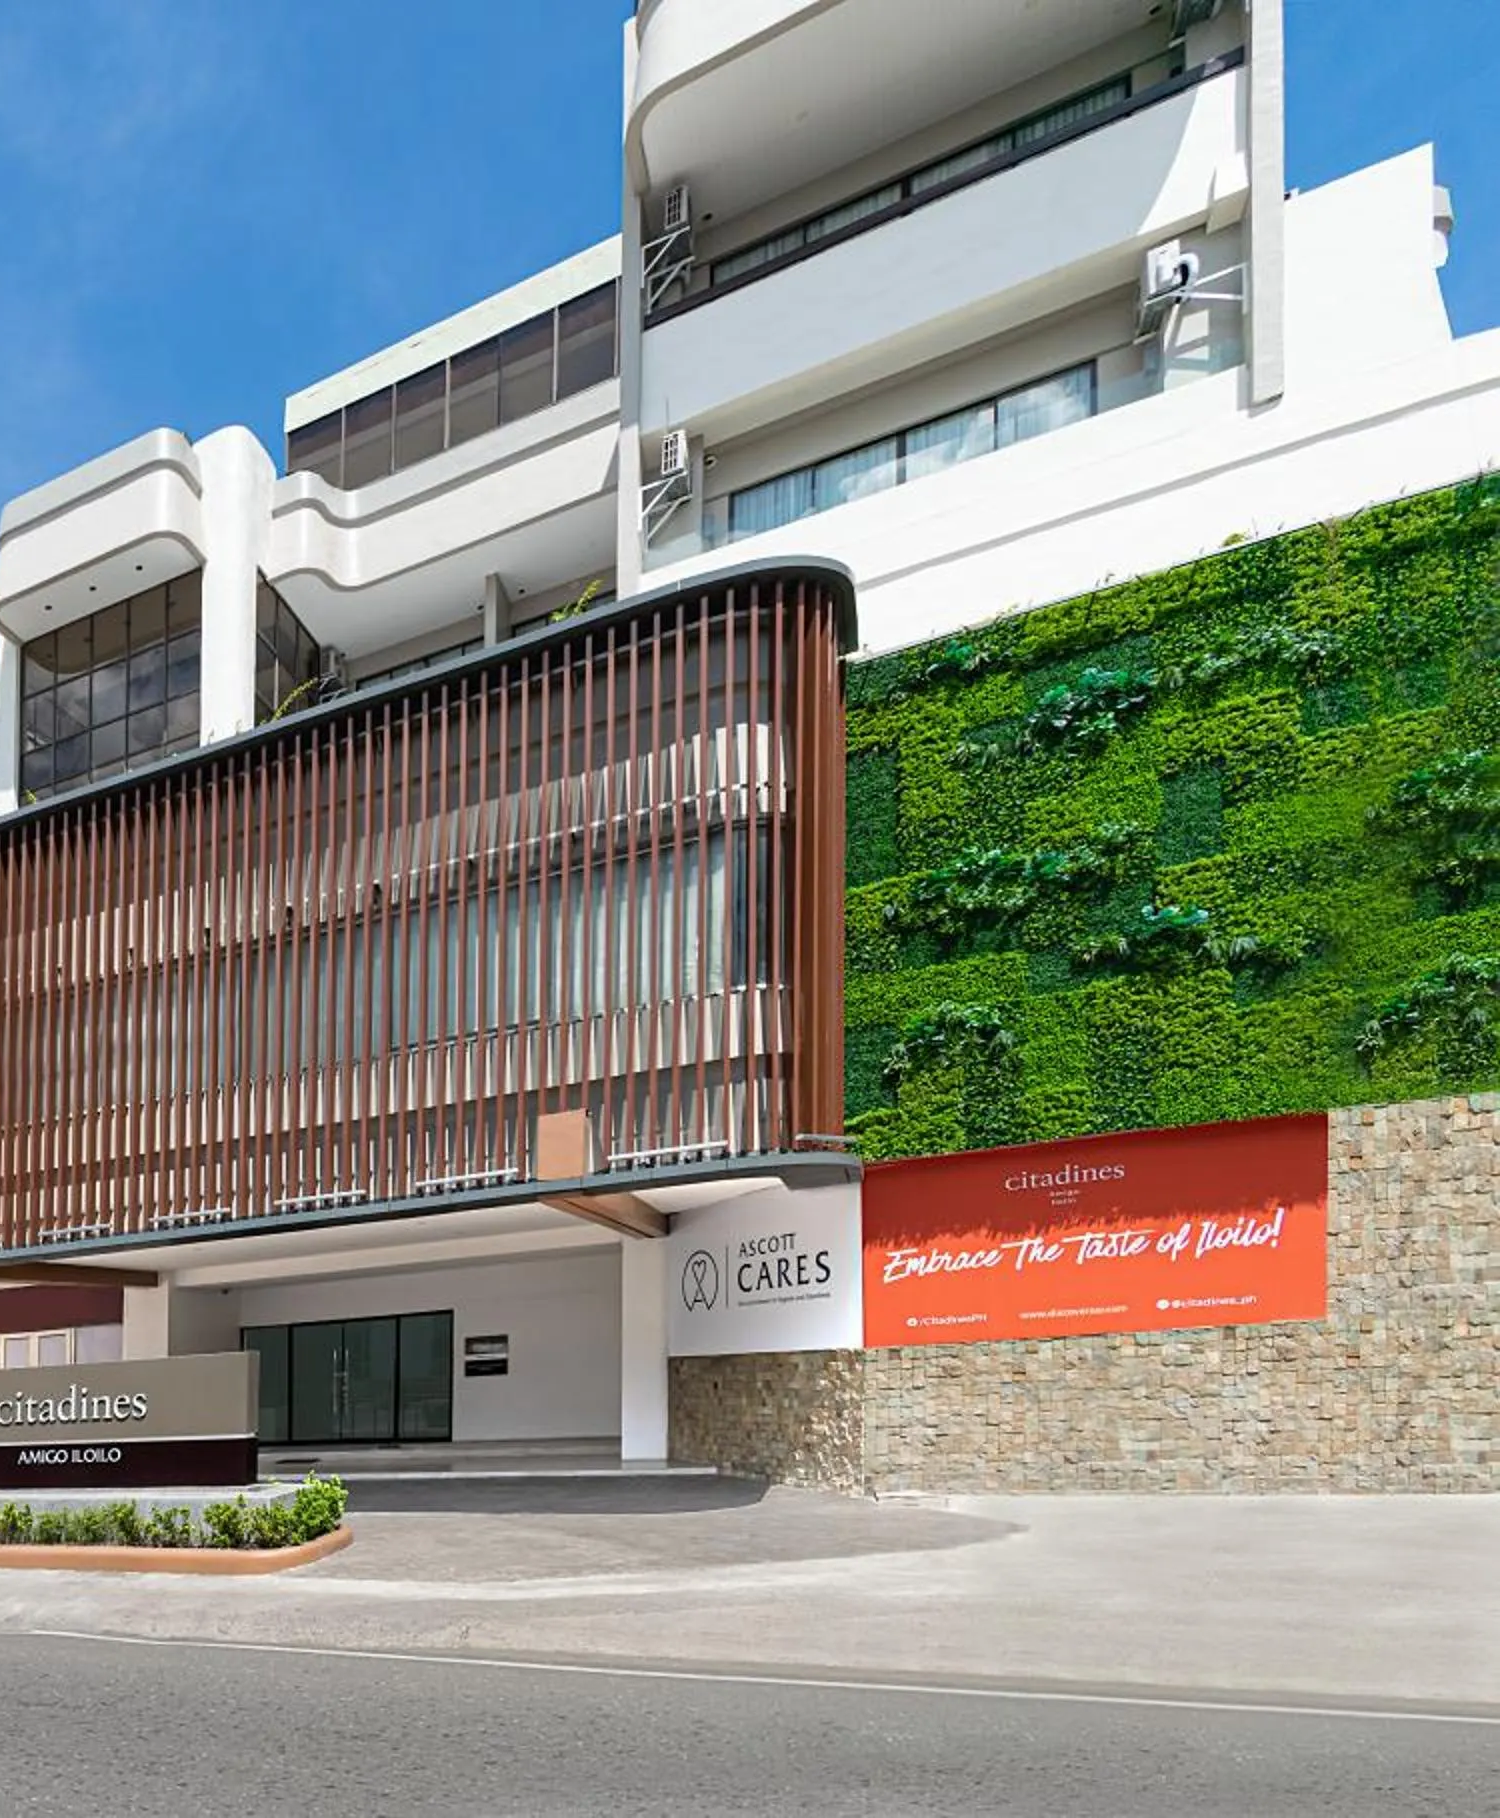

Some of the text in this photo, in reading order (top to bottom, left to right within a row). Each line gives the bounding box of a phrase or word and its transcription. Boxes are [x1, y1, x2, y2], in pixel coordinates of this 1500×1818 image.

[1004, 1163, 1125, 1191] citadines
[739, 1232, 796, 1258] ASCOTT
[884, 1207, 1285, 1285] Embrace The Taste of Iloilo!
[737, 1250, 831, 1293] CARES
[17, 1447, 122, 1465] AMIGO ILOILO
